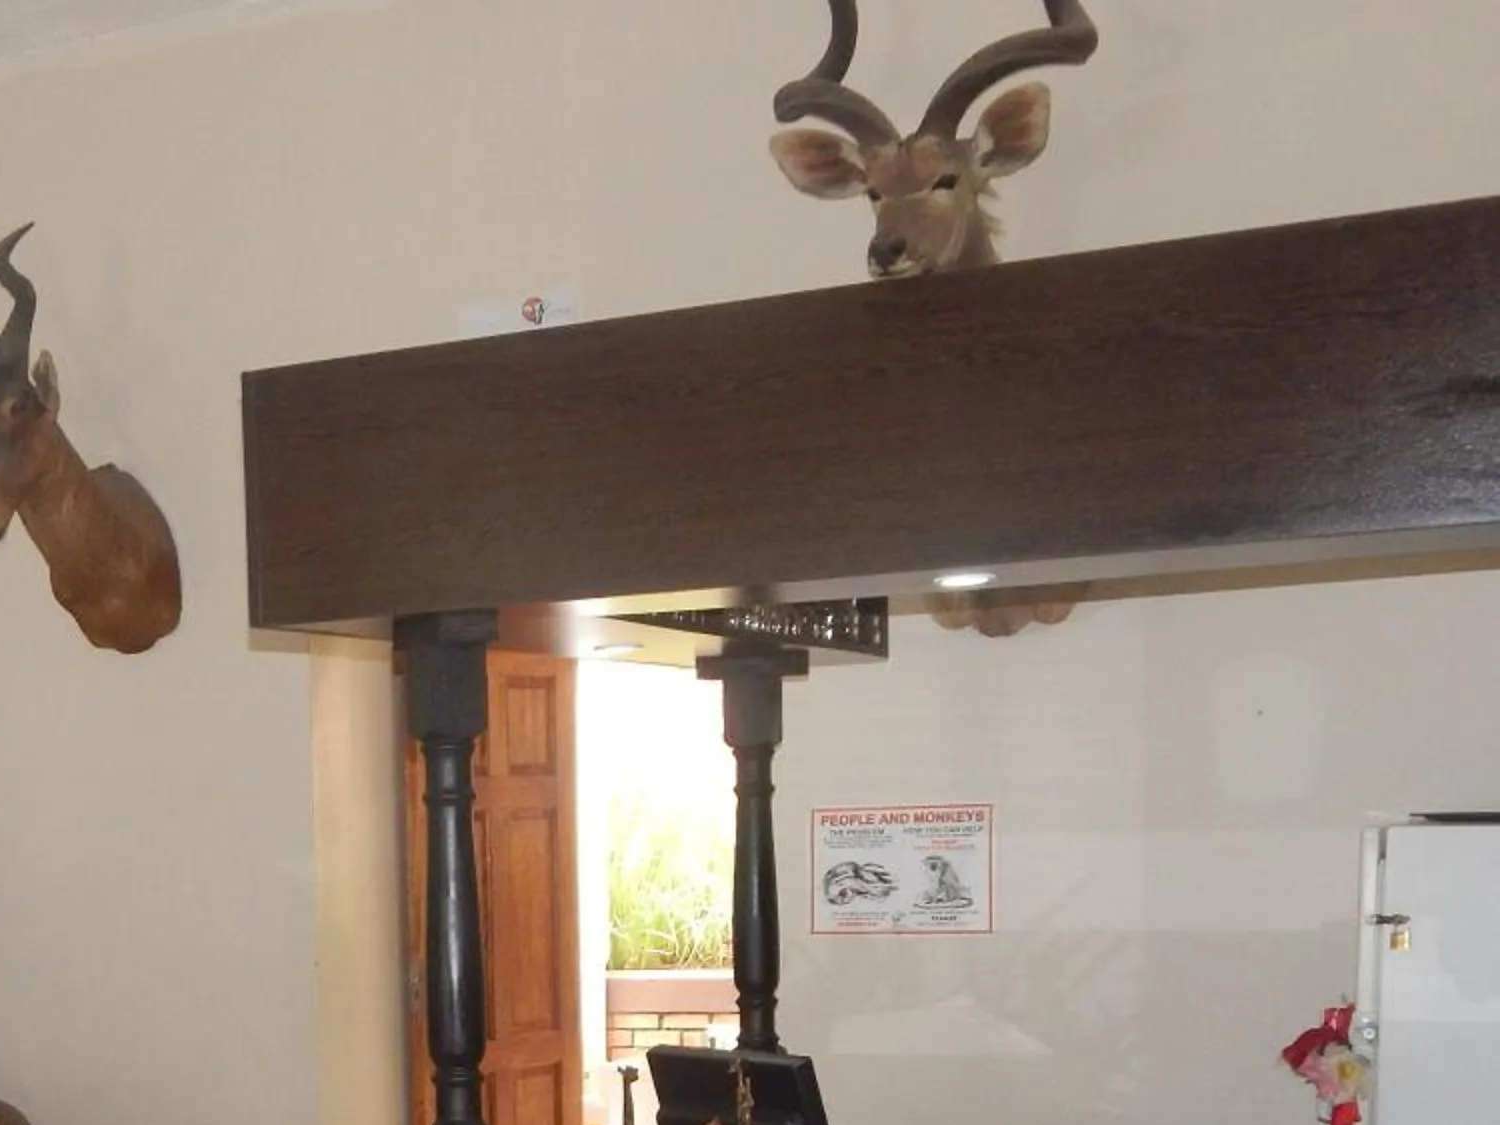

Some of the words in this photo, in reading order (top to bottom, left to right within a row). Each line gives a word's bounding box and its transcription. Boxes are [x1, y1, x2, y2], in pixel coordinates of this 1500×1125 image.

[821, 814, 875, 826] PEOPLE
[879, 812, 910, 825] AND
[913, 810, 985, 824] MONKEYS
